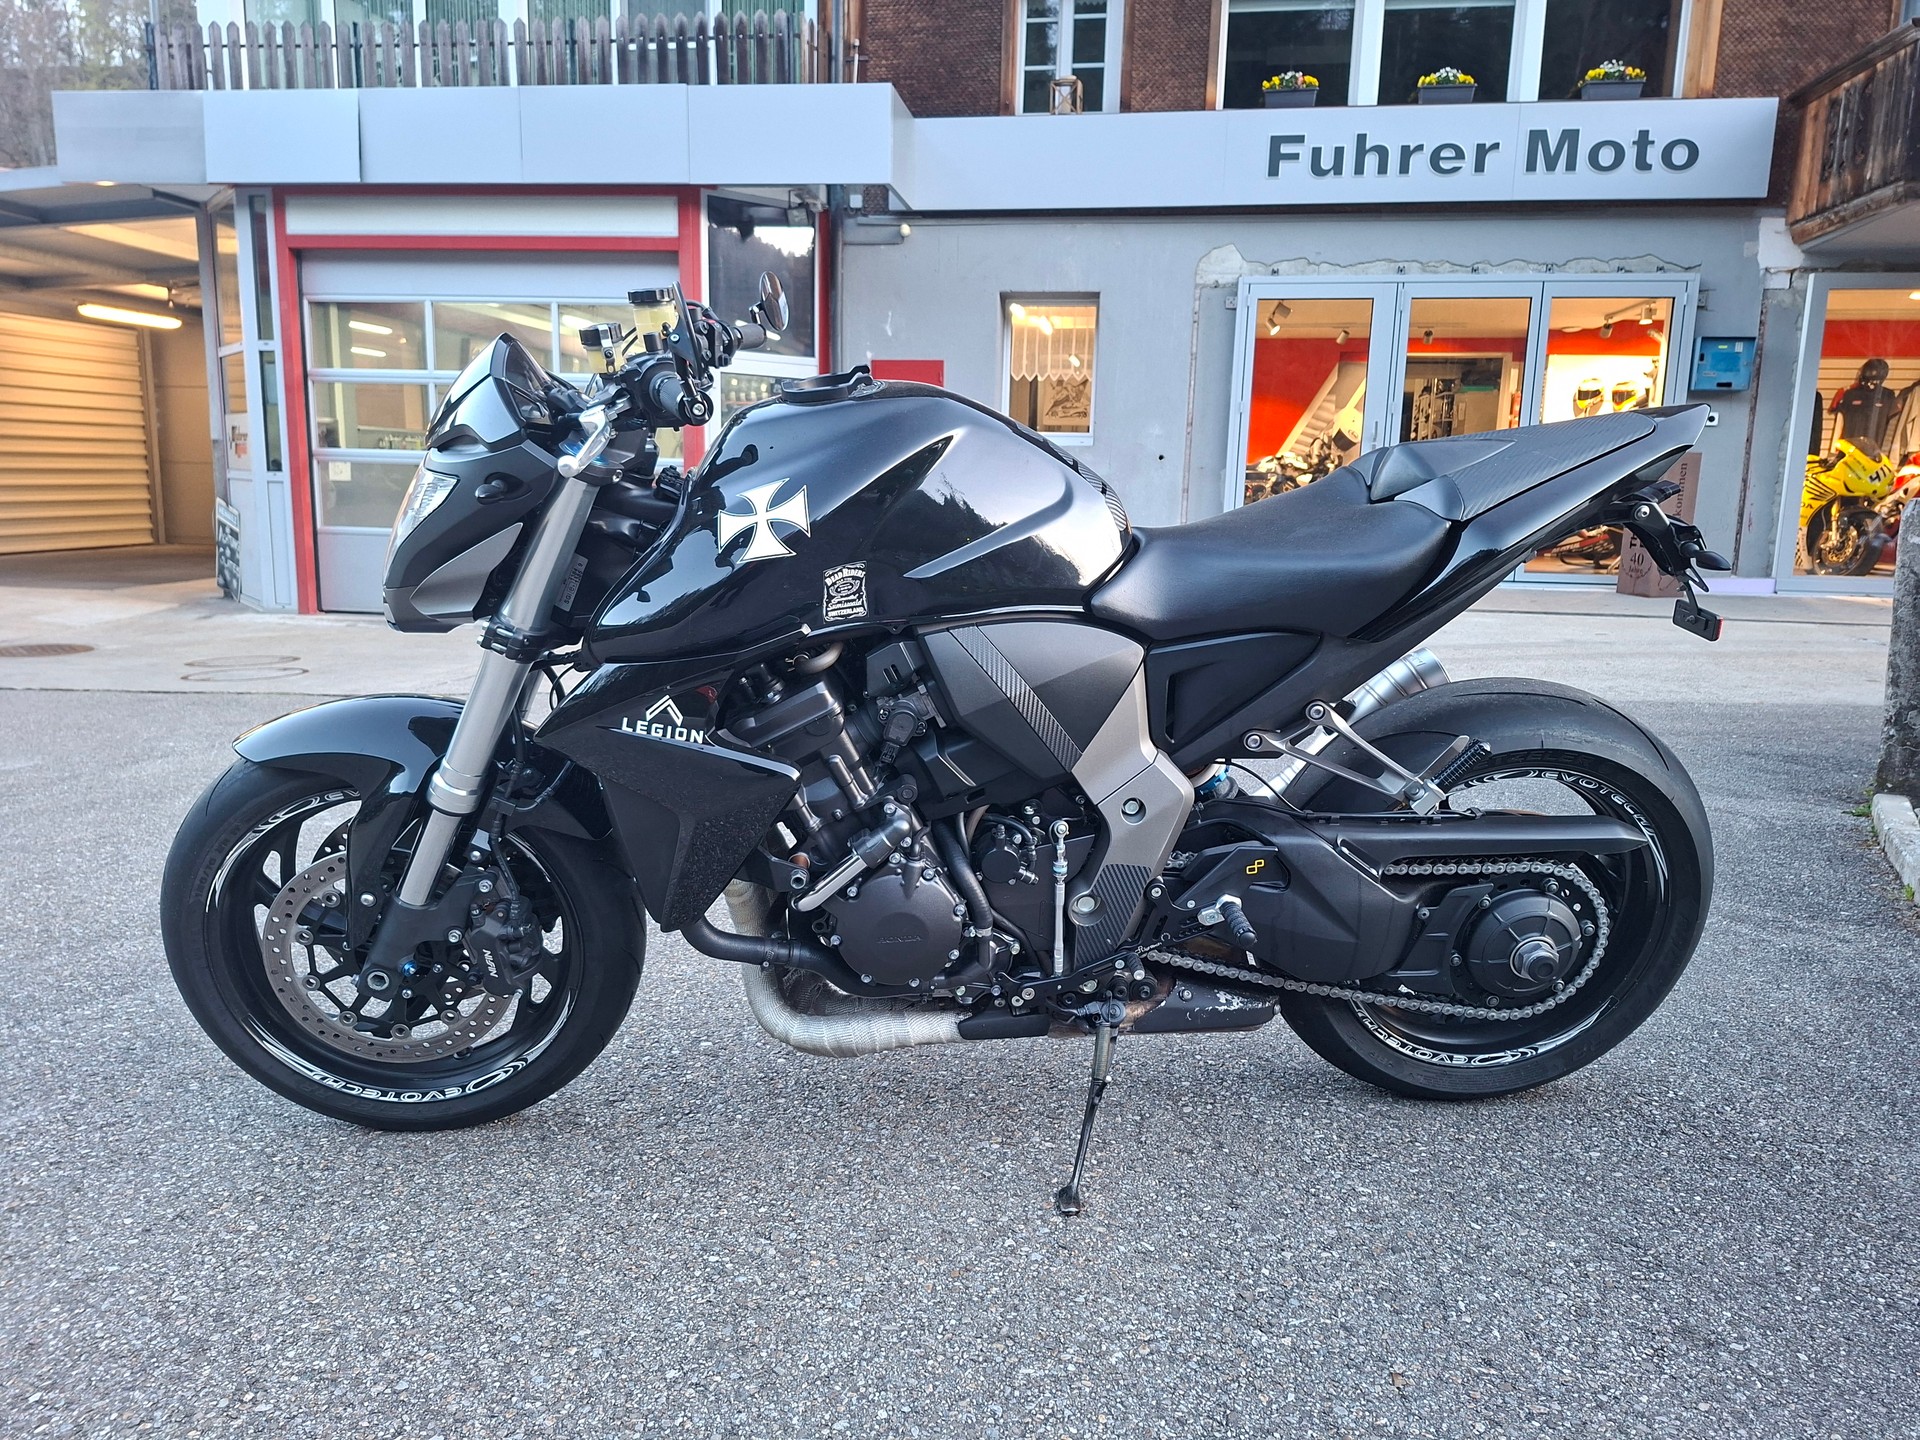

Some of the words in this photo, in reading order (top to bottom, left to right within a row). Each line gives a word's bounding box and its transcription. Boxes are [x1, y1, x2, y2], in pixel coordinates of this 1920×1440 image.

[1266, 132, 1500, 178] Fuhrer
[1525, 128, 1701, 173] Moto
[1868, 463, 1892, 483] 411
[1673, 462, 1688, 517] kommen
[1630, 552, 1645, 567] 40
[621, 717, 704, 744] LEGION
